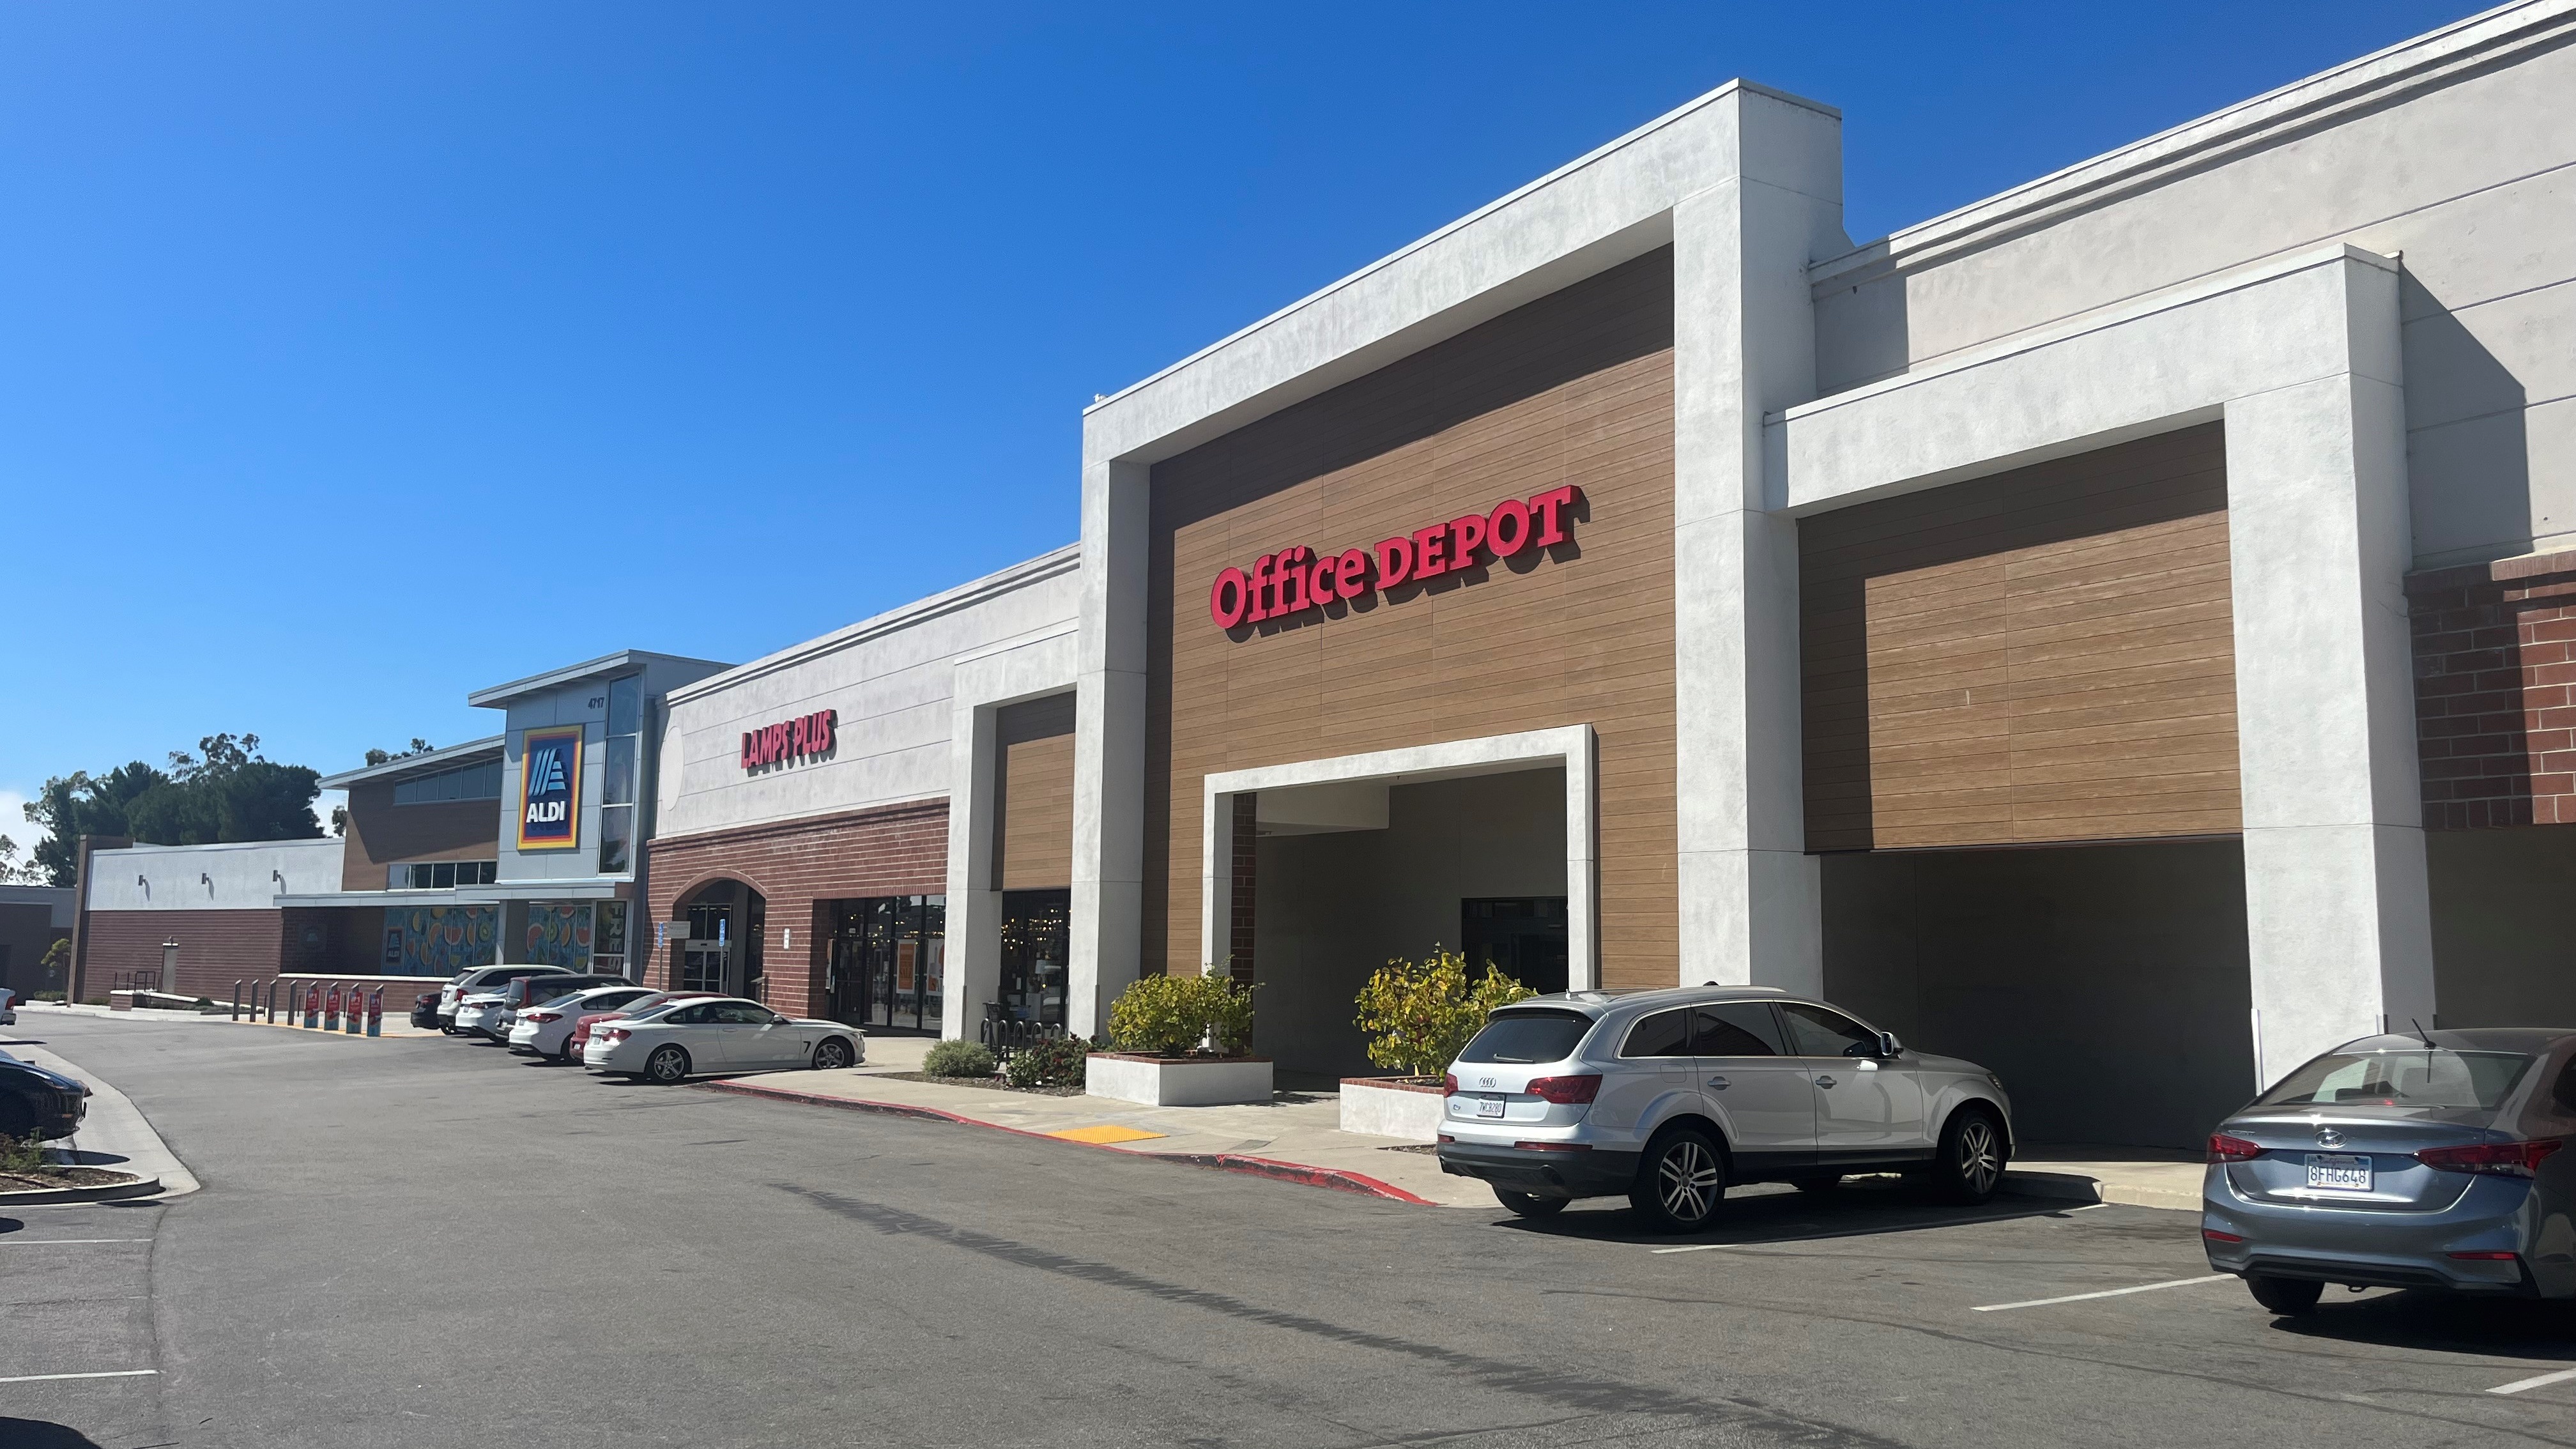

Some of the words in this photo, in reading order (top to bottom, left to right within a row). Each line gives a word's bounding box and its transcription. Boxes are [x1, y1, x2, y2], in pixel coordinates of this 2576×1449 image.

[1210, 545, 1366, 629] Office
[1374, 484, 1573, 591] DEPOT
[588, 696, 604, 709] 4717
[741, 720, 791, 769] LAMPS
[793, 709, 832, 756] PLUS
[526, 800, 566, 824] ALDI
[2310, 1165, 2366, 1184] 8FHG648
